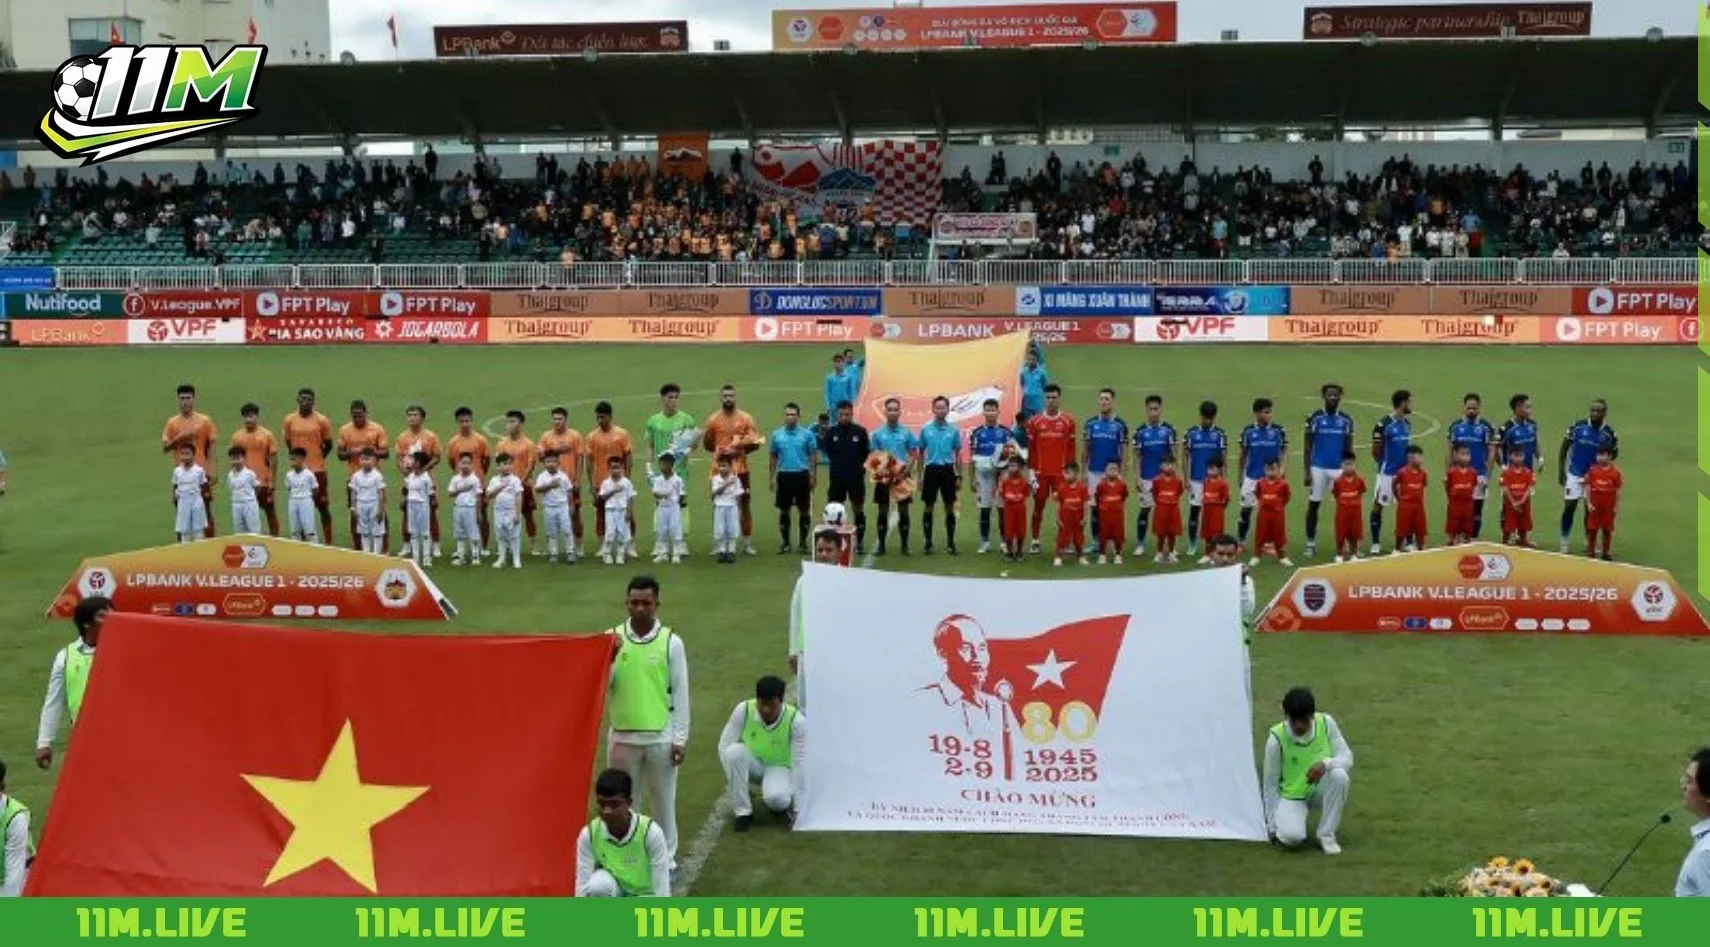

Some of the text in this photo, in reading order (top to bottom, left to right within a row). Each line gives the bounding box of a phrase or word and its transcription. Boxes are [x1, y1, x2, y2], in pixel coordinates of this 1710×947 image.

[1341, 14, 1411, 32] Strategic
[442, 36, 500, 52] LPBank
[25, 293, 101, 311] Nutifood
[281, 297, 350, 314] FPT Play
[405, 297, 475, 314] FPT Play
[1043, 293, 1054, 307] XI
[1617, 293, 1695, 312] FPT Play
[171, 319, 217, 337] VPF
[294, 328, 323, 339] SAO
[326, 326, 364, 340] VÀNG
[781, 321, 853, 339] FPT Play
[918, 323, 995, 339] LPBANK
[1004, 321, 1069, 332] V.LEAGUE
[1186, 318, 1235, 334] VPF
[1584, 322, 1662, 339] FPT Play
[126, 574, 192, 588] LPBANK
[196, 575, 273, 588] V.LEAGUE
[277, 575, 286, 588] 1
[297, 575, 364, 589] 2025/26
[1348, 585, 1422, 599] LPBANK
[1428, 586, 1516, 600] V.LEAGUE
[1521, 587, 1530, 600] 1
[1544, 587, 1619, 602] 2025/26
[1020, 700, 1097, 745] 80
[928, 734, 992, 760] 19-8
[1024, 748, 1097, 766] 1945
[944, 757, 993, 780] 2-9
[1025, 767, 1098, 782] 2025
[960, 788, 1022, 804] CHÀO
